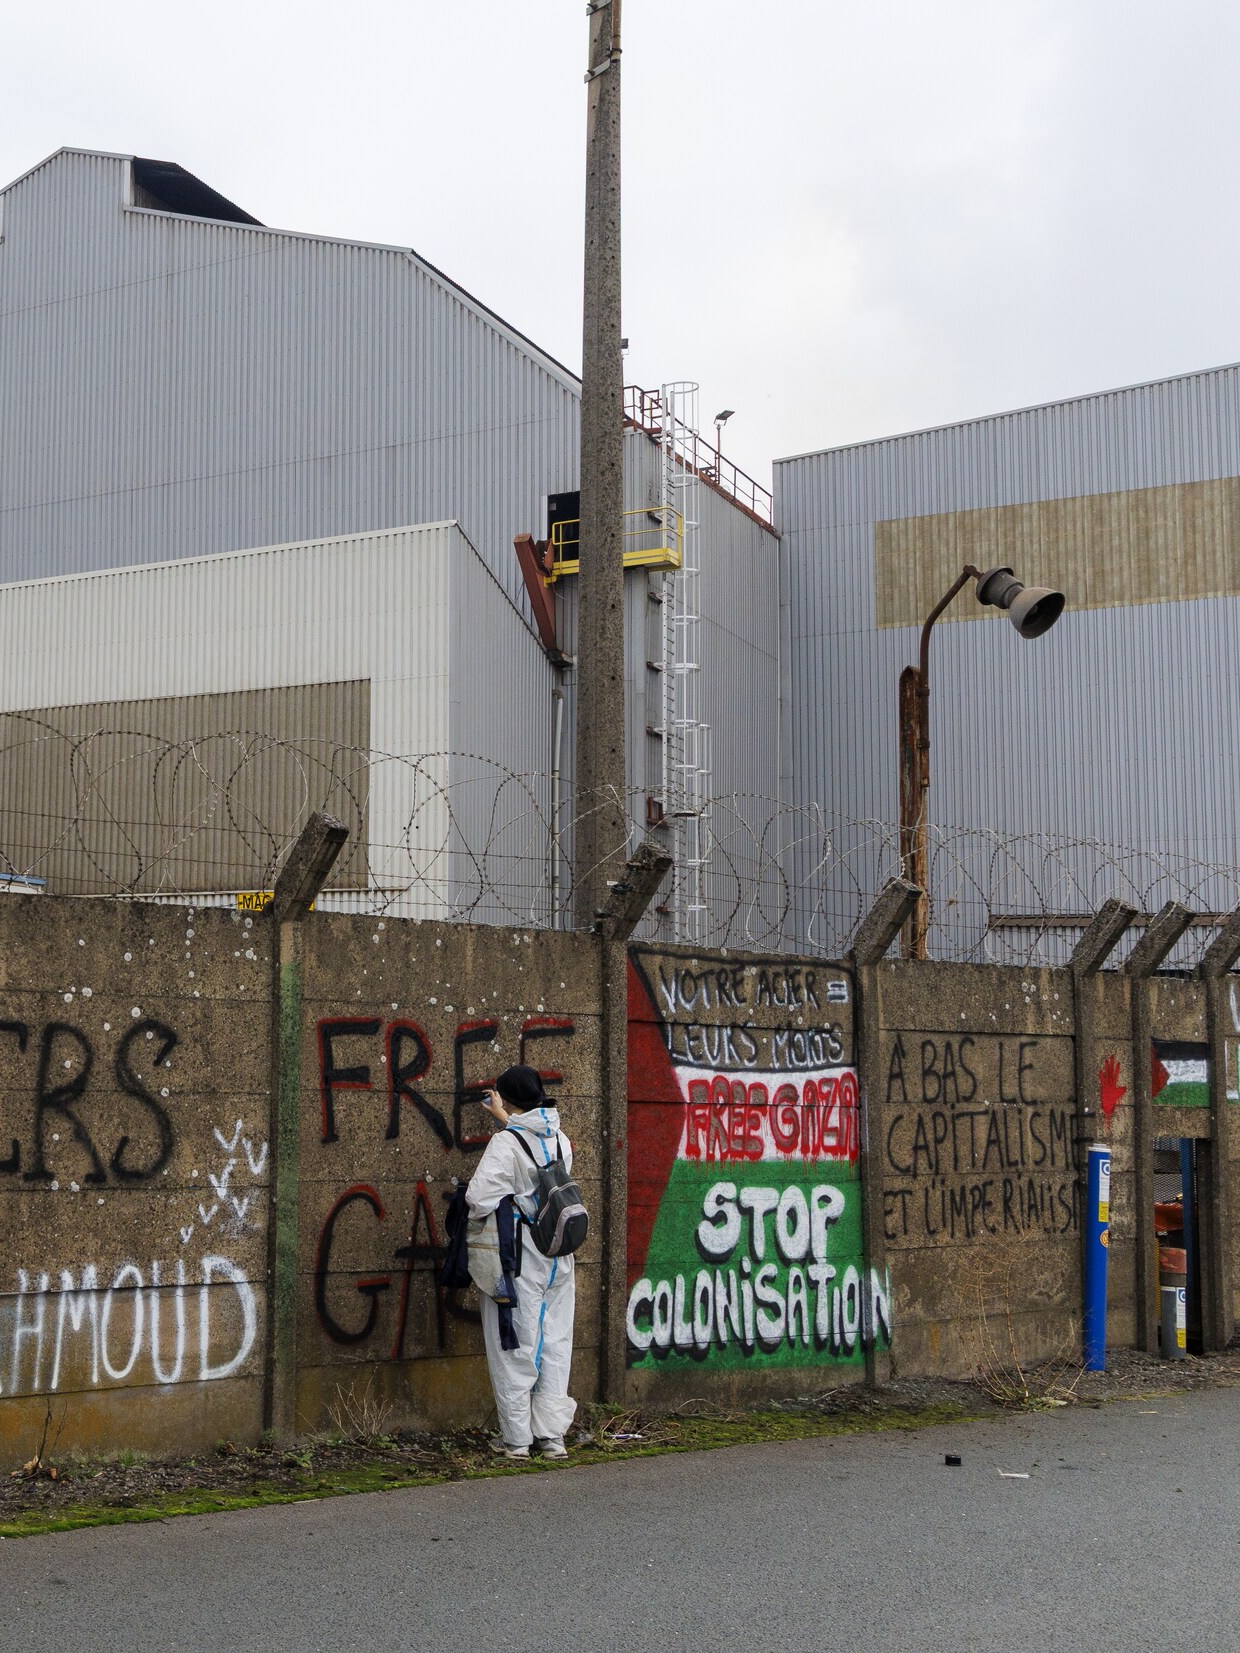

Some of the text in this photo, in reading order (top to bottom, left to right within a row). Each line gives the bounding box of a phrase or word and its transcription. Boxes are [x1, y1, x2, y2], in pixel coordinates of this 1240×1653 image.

[659, 964, 748, 1014] VOTRE
[665, 1020, 759, 1067] LEURS
[921, 1036, 978, 1105] BAS
[999, 1041, 1039, 1106] LE
[685, 1071, 859, 1162] FREE GAZA
[696, 1181, 846, 1264] STOP
[883, 1188, 913, 1241] ET
